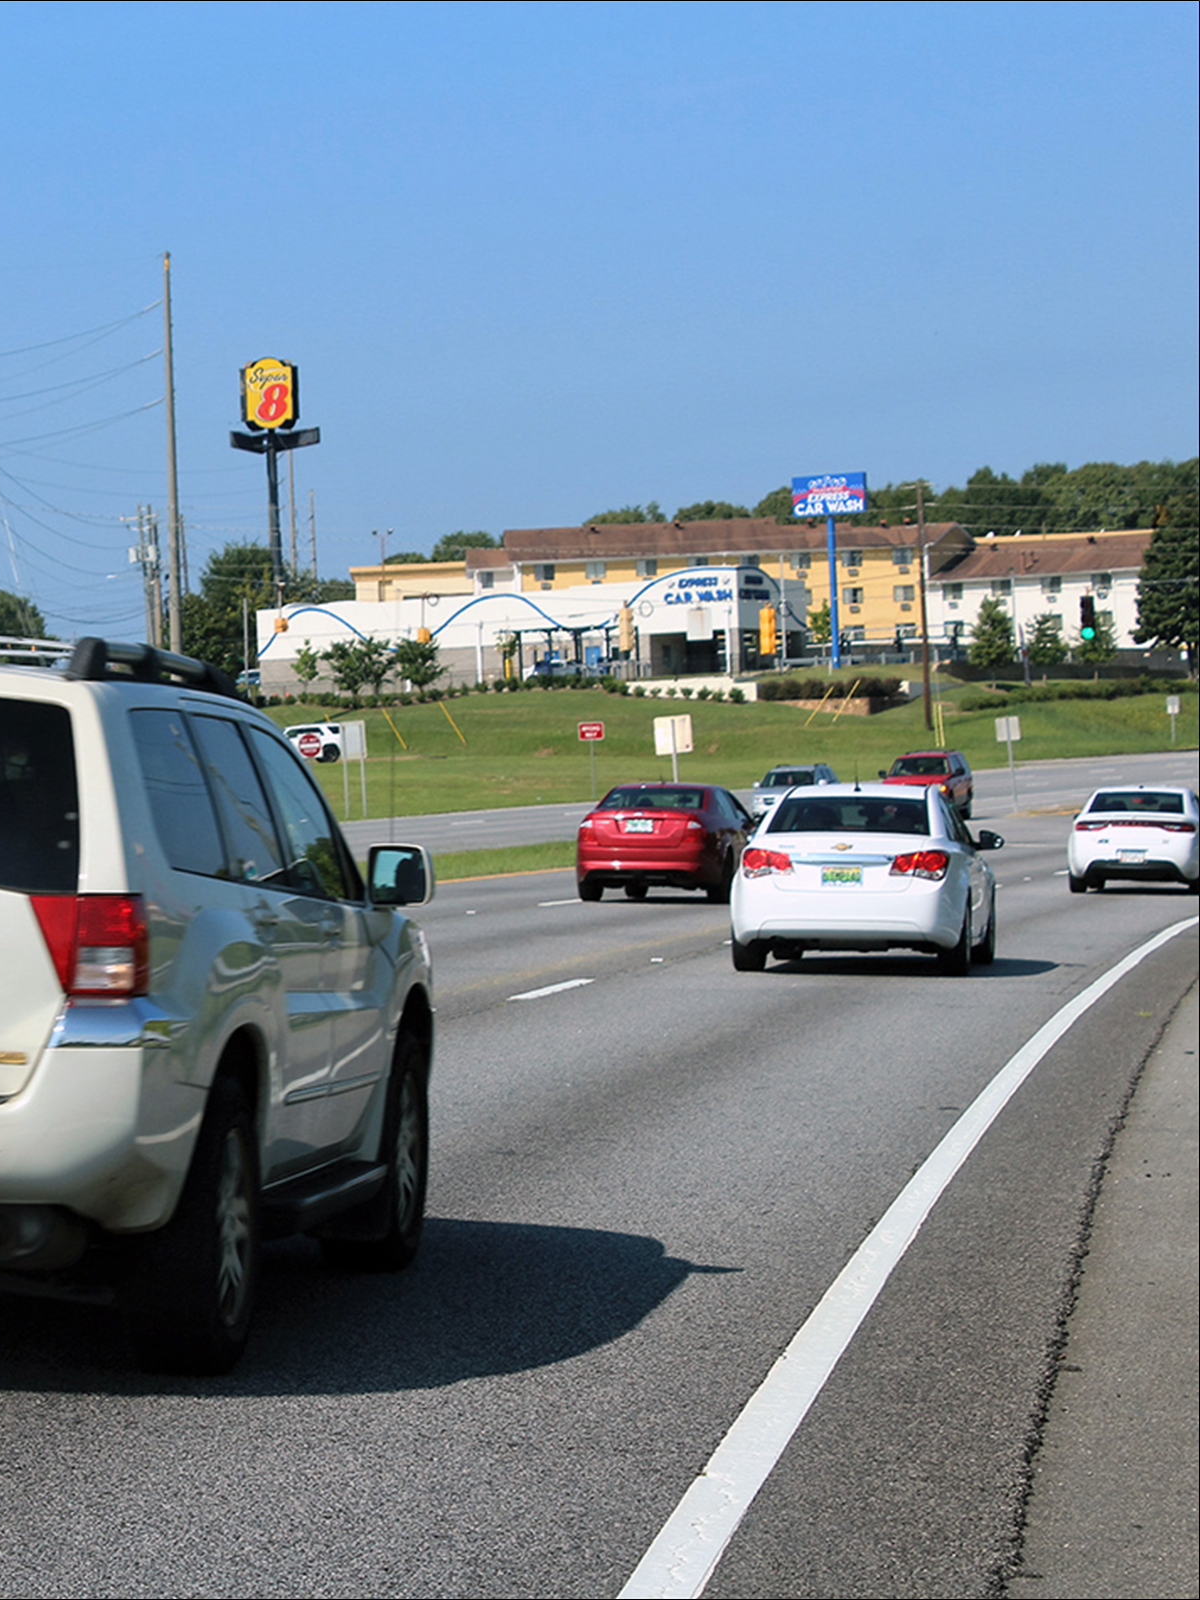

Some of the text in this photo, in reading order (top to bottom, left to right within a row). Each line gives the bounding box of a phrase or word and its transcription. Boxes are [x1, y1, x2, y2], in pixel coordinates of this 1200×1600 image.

[249, 367, 288, 390] Super
[256, 383, 289, 422] 8
[794, 499, 864, 517] CAR WASH
[664, 592, 693, 605] CAR
[695, 588, 733, 601] WASH
